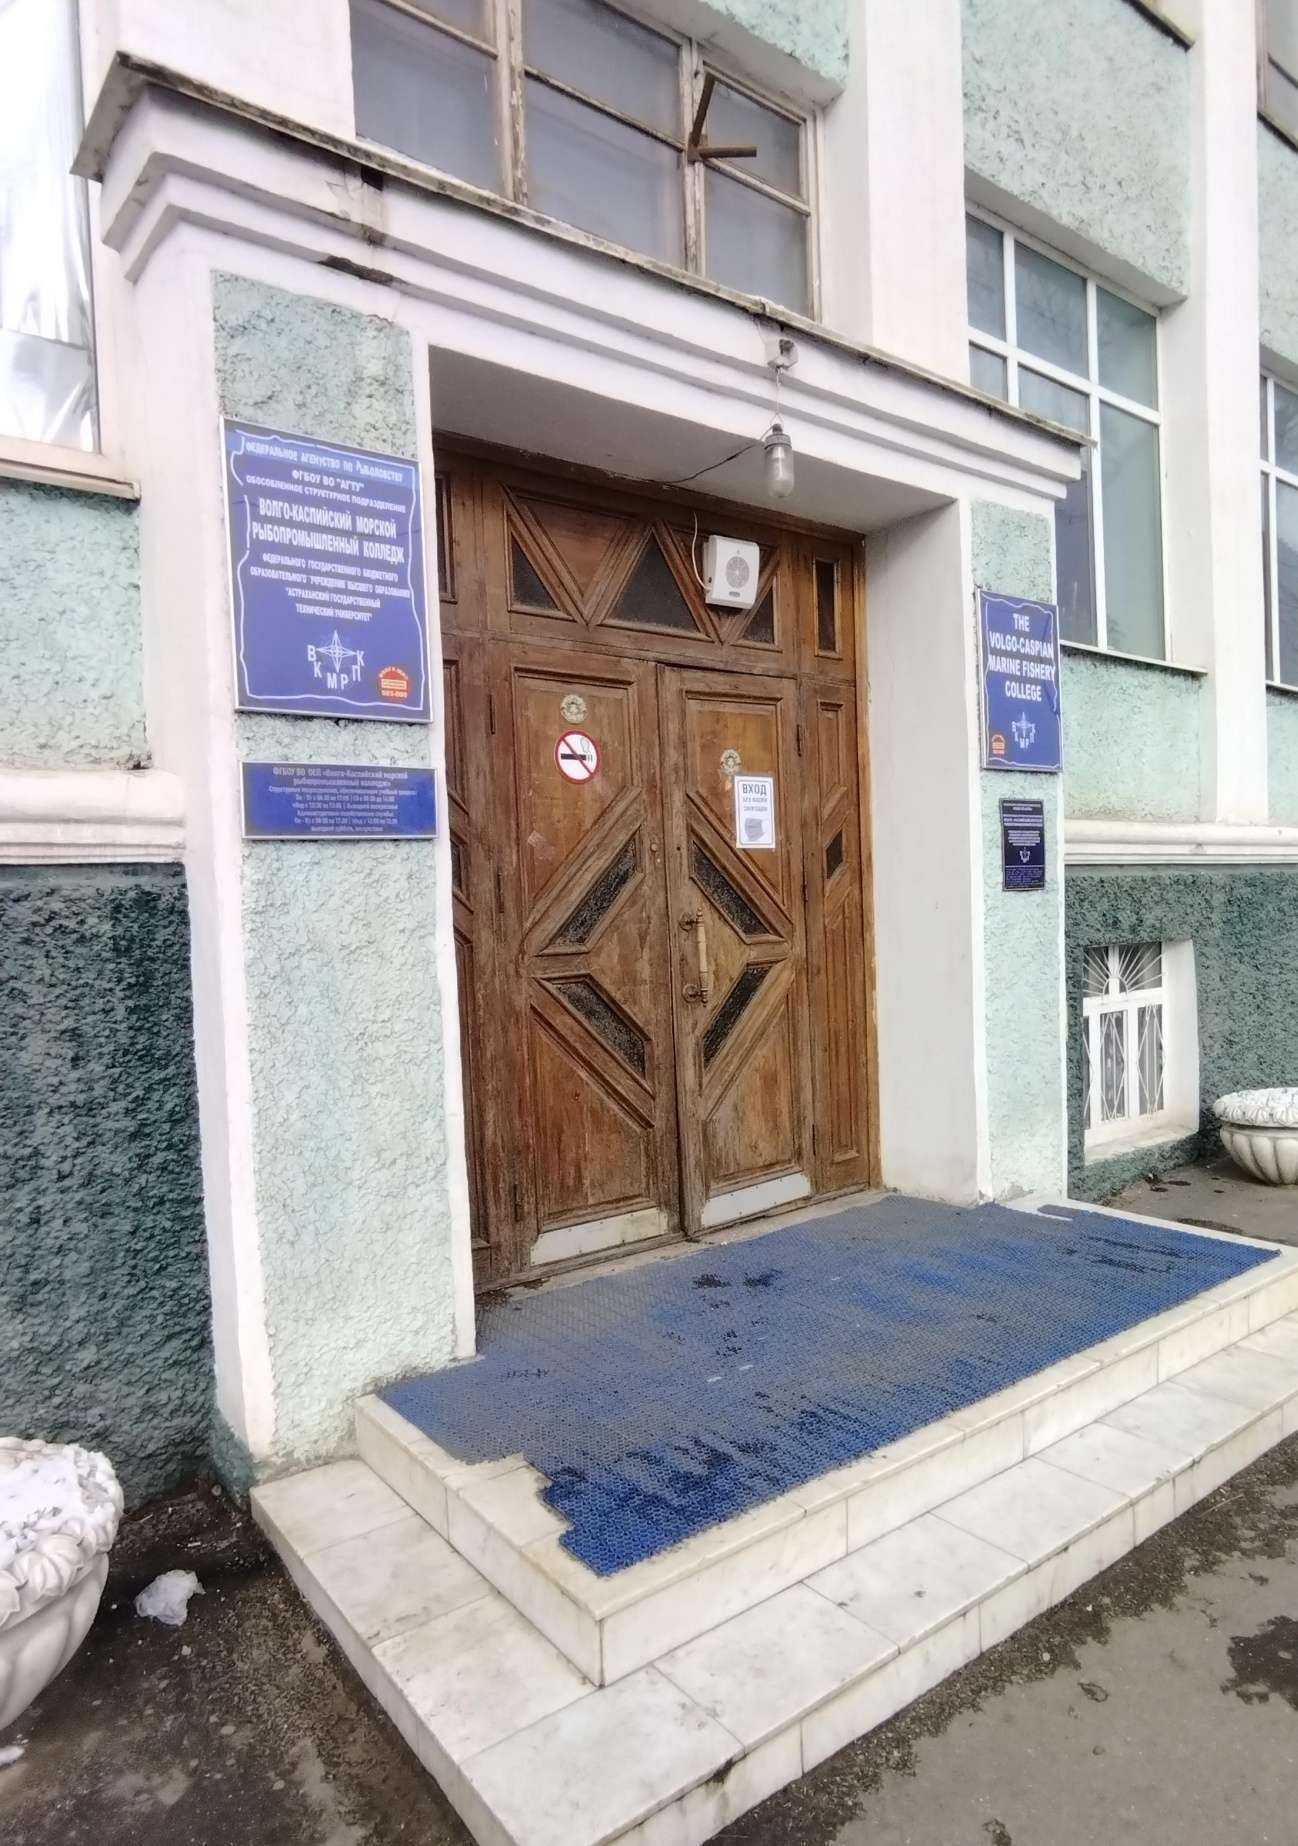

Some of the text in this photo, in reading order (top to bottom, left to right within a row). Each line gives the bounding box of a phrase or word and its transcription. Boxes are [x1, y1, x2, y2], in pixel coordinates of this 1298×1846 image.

[343, 460, 353, 472] ПО
[292, 469, 364, 492] ФГБОУ ВО "АГТУ"
[246, 474, 406, 513] ОБОСОБЛЕННОЕ СТРУКТУРНОЕ ПОДРАЗДЕЛЕНИЕ
[259, 497, 397, 539] ВОЛГО-КАСПИЙСКИЙ МОРСКОЙ
[252, 521, 405, 565] РЫБОПРОМЫШЛЕННЫЙ КОЛЛЕДЖ
[250, 566, 307, 584] ОБРАЗОВАТЕЛЬНОГО
[263, 552, 306, 569] ФЕДЕРАЛЬНОГО
[308, 560, 362, 577] ГОСУДАРСТВЕННОГО
[330, 592, 381, 608] ГОСУДАРСТВЕННЫЙ
[1013, 613, 1030, 632] THE
[989, 631, 1055, 659] VOLGO-CASPIAN
[988, 654, 1056, 682] MARINE FISHERY
[1005, 681, 1042, 701] COLLEGE
[742, 783, 767, 796] ВХОД
